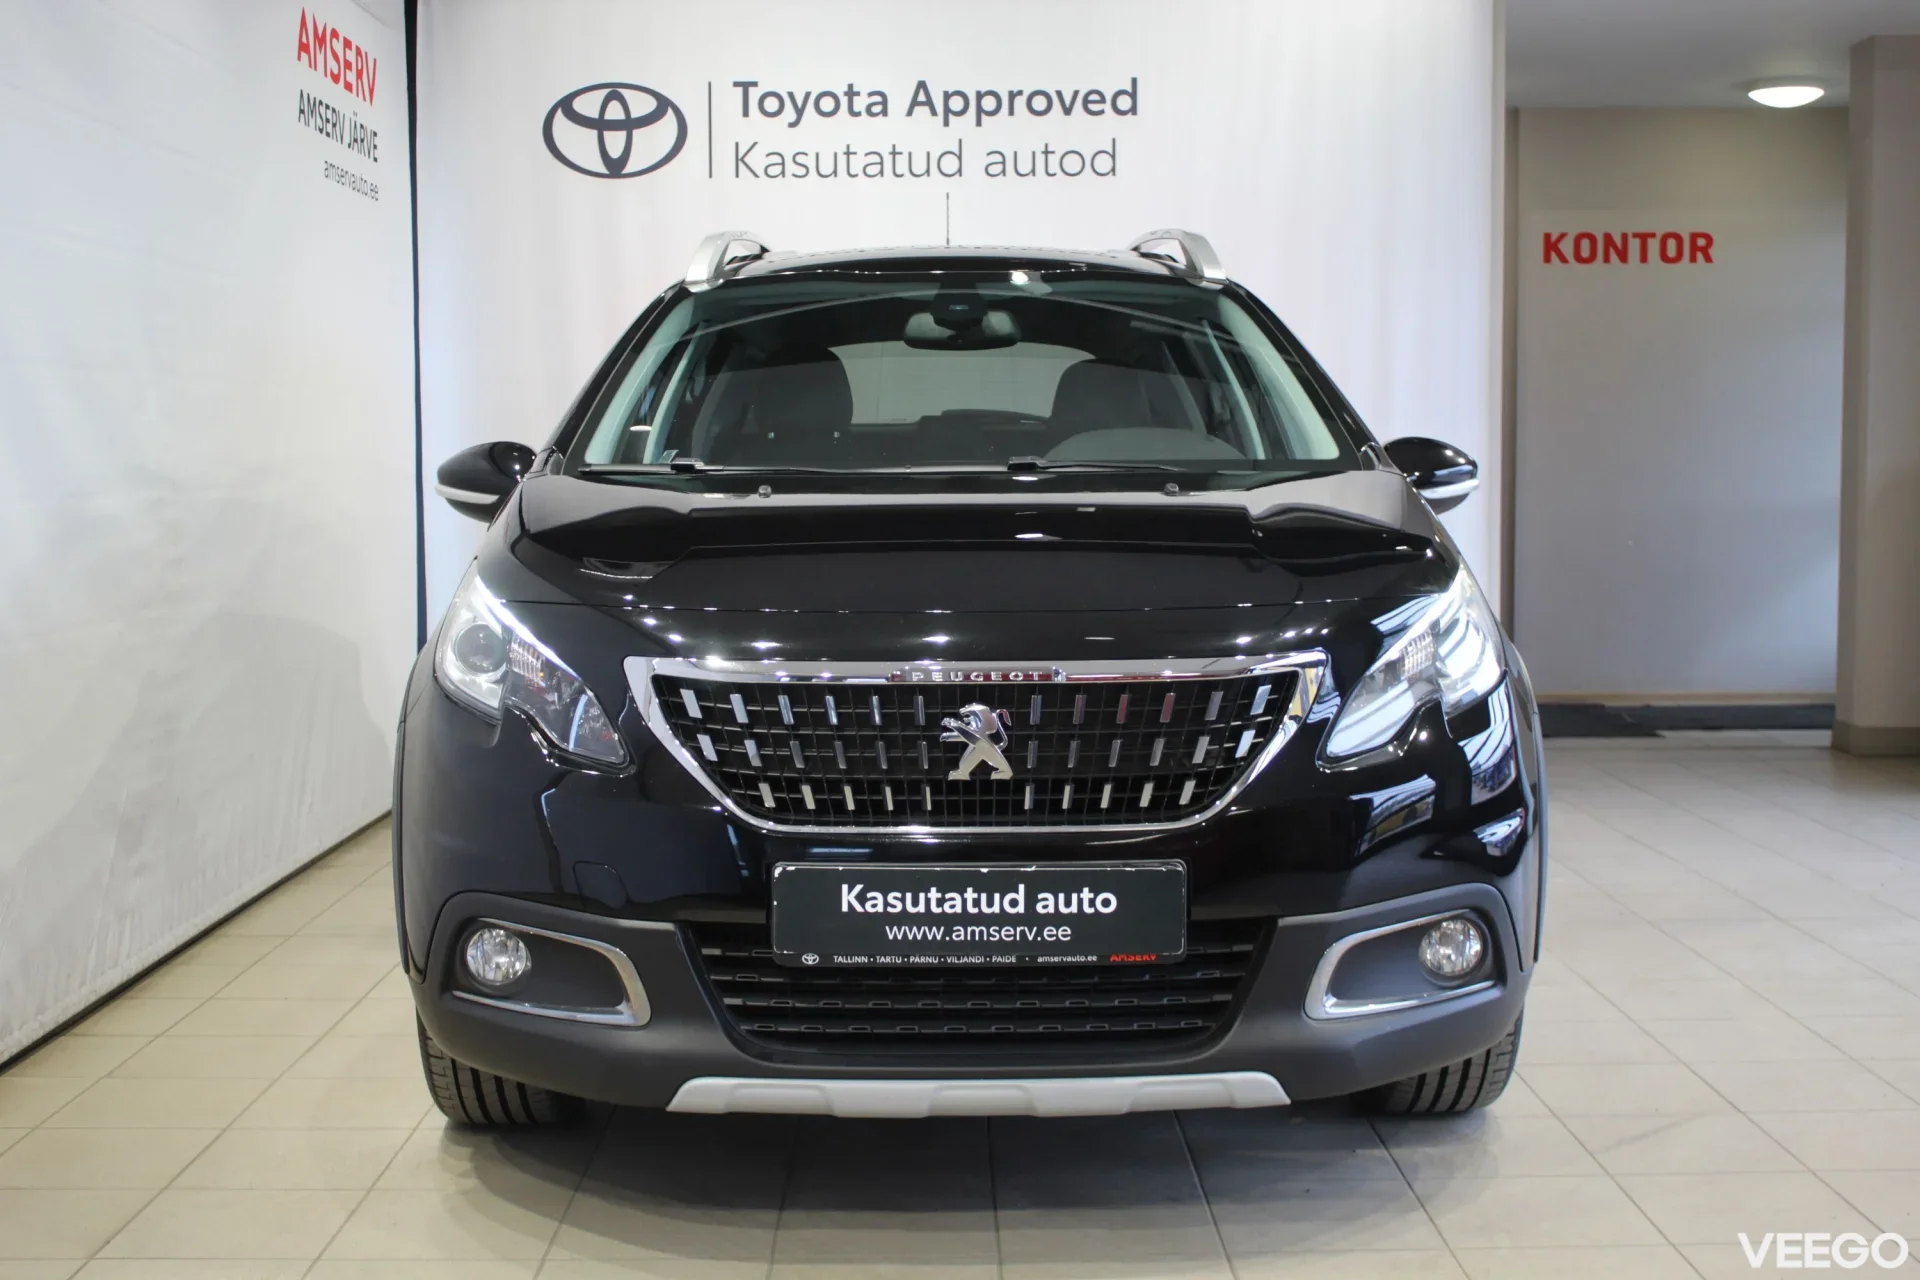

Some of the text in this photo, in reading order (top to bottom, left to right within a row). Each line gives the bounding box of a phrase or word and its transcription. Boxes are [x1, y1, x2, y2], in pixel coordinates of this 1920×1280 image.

[297, 6, 377, 107] AMSERV
[733, 77, 1139, 129] Toyota Approved
[298, 88, 378, 163] AMSERV JÄRVE
[734, 137, 1117, 179] Kasutatud autod
[324, 160, 379, 201] amservauto.ee
[1543, 231, 1714, 265] KONTOR
[912, 671, 1043, 682] PEUGEOT
[841, 883, 1117, 914] Kasutatud auto
[885, 924, 1072, 941] www.amserv.ee
[833, 953, 1157, 963] TALLINN TARTU PÄRNU VILJANDI PAIDE amservauto.ee AMSERV
